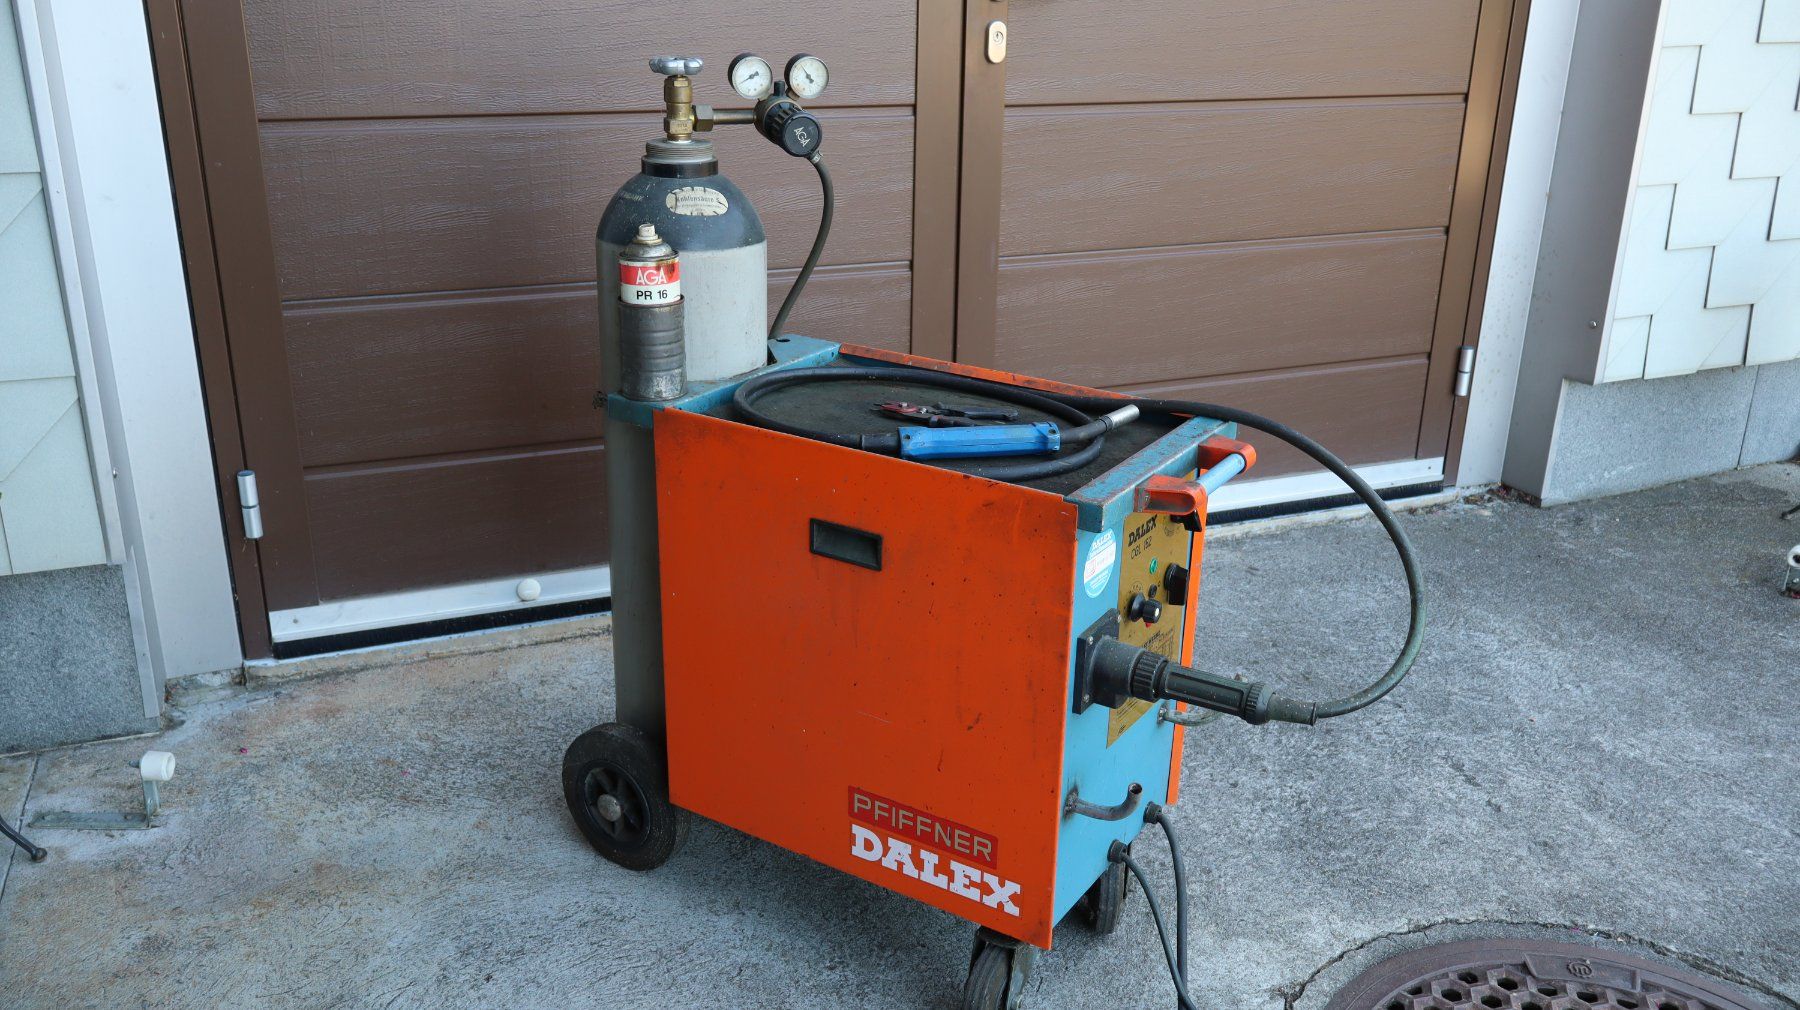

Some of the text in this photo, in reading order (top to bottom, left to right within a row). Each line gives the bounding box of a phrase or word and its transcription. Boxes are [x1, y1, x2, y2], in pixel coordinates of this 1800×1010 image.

[793, 126, 811, 147] AGA
[635, 267, 667, 286] AGA
[636, 289, 668, 300] PR 16
[1128, 513, 1158, 547] DALEX
[853, 792, 993, 862] PFIFFNER
[851, 823, 1021, 917] DALEX
